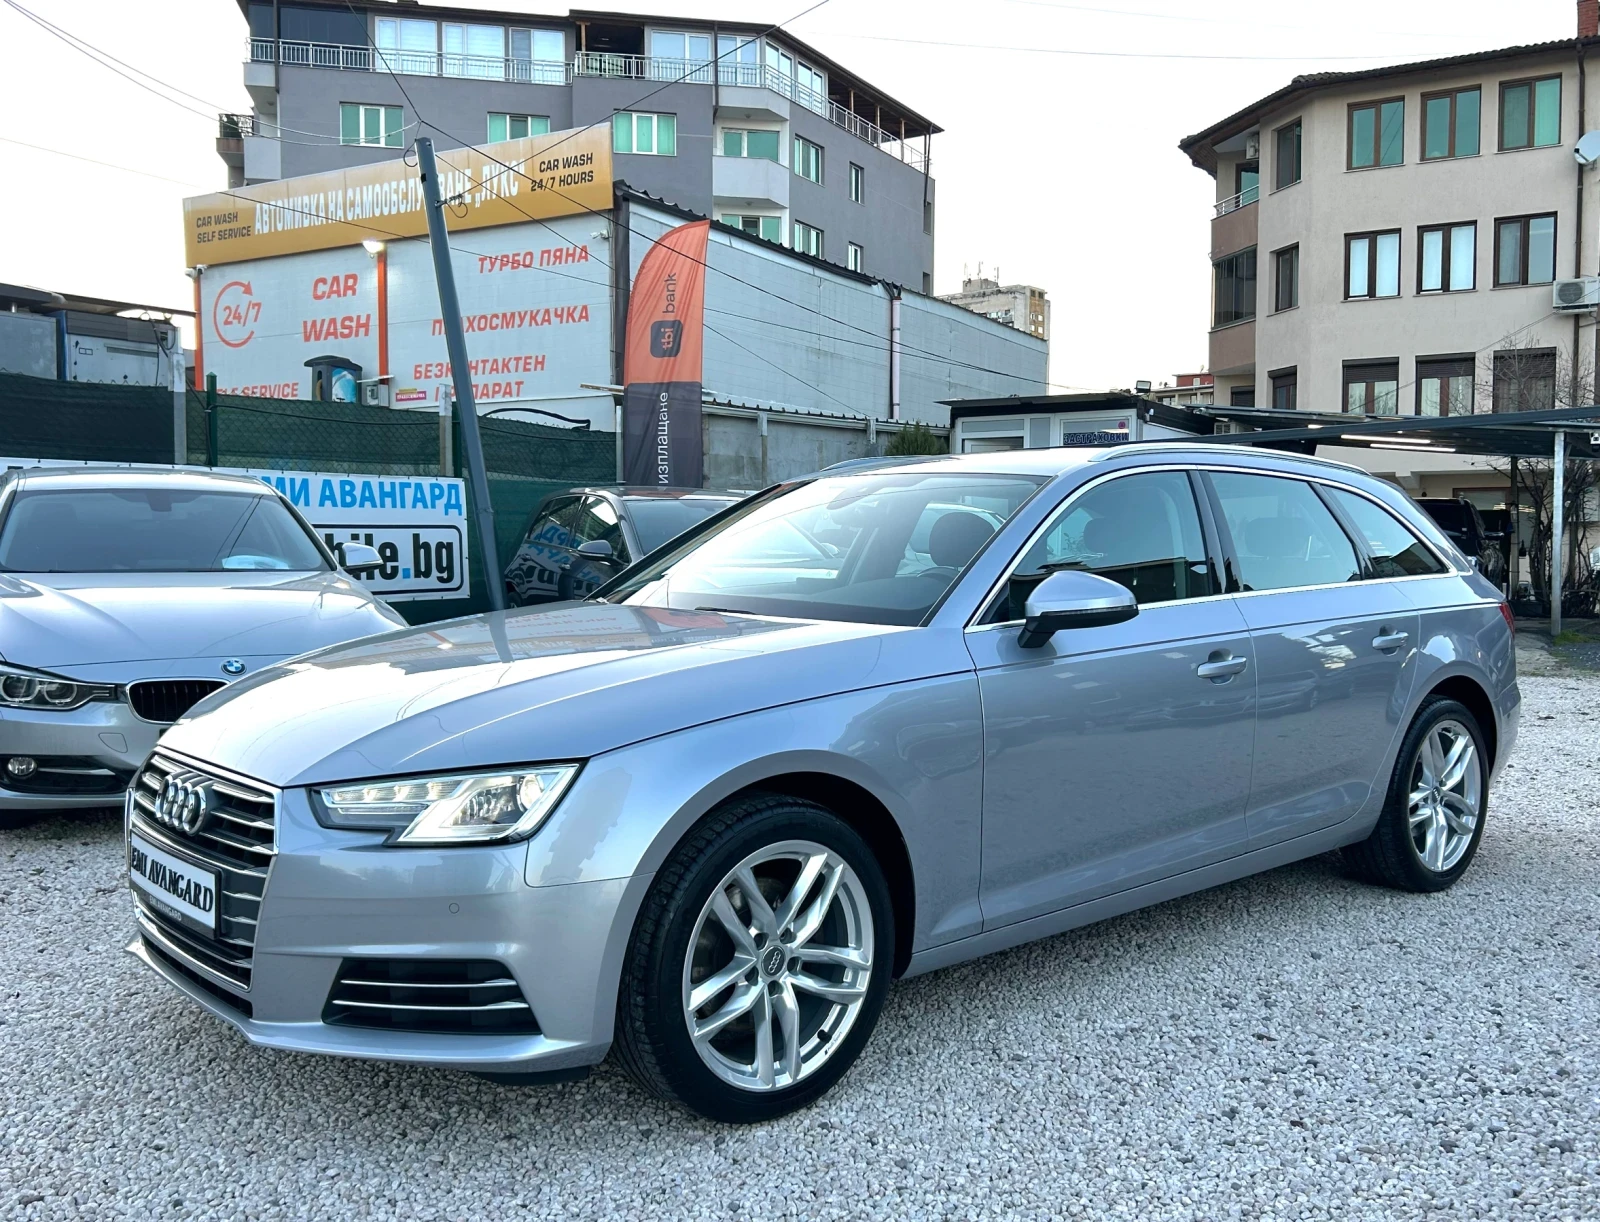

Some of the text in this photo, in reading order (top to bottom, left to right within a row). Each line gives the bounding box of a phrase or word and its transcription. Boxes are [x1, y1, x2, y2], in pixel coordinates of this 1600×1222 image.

[538, 152, 593, 173] CAR WASH
[531, 170, 594, 192] 24/7 HOURS
[255, 192, 326, 236] АВТОМИВКА
[328, 189, 344, 222] НА
[346, 168, 472, 221] САМООБСЛУВАНЕ
[196, 211, 238, 229] CAR WASH
[197, 225, 251, 244] SELF SERVICE
[478, 245, 589, 274] ТУРБО ПЯНА
[312, 273, 358, 301] CAR
[223, 300, 262, 327] 24/7
[432, 304, 590, 336] ПХОСМУКАЧКА
[662, 272, 677, 350] tbi bank
[302, 313, 371, 342] WASH
[413, 354, 546, 380] БЕЗКНТАКТЕН
[658, 392, 669, 484] изплащане
[1064, 433, 1129, 444] ЗАСТРАХОВКИ
[318, 479, 463, 516] АВАНГАРД
[147, 859, 214, 913] AVANGARD
